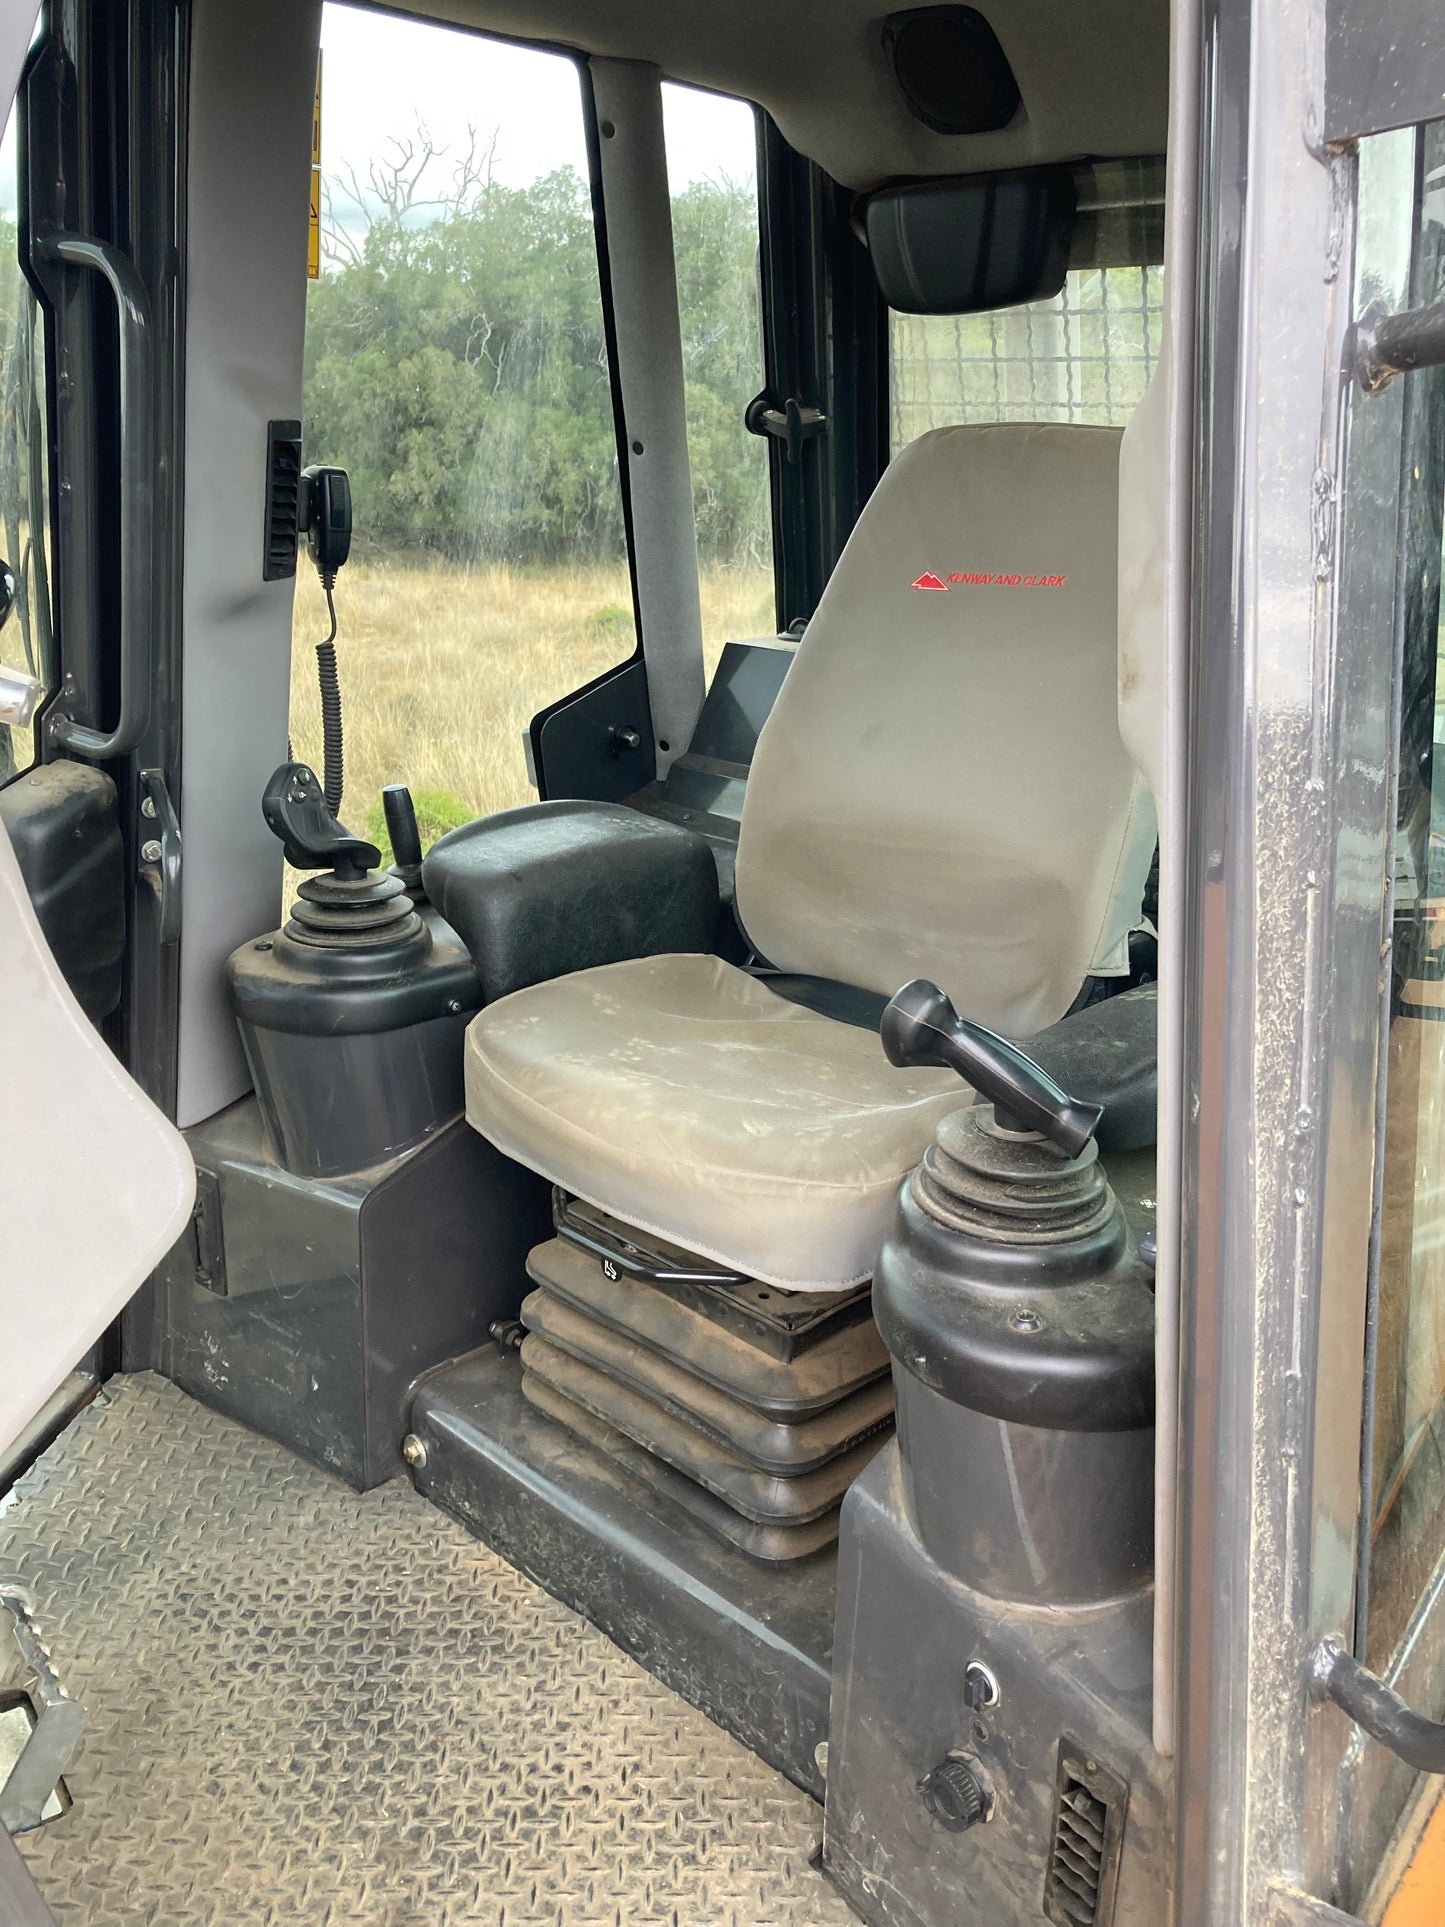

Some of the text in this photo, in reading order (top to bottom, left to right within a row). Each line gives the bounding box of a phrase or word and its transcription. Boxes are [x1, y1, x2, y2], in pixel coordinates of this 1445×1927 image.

[947, 573, 1065, 587] KENWAY AND CLARK
